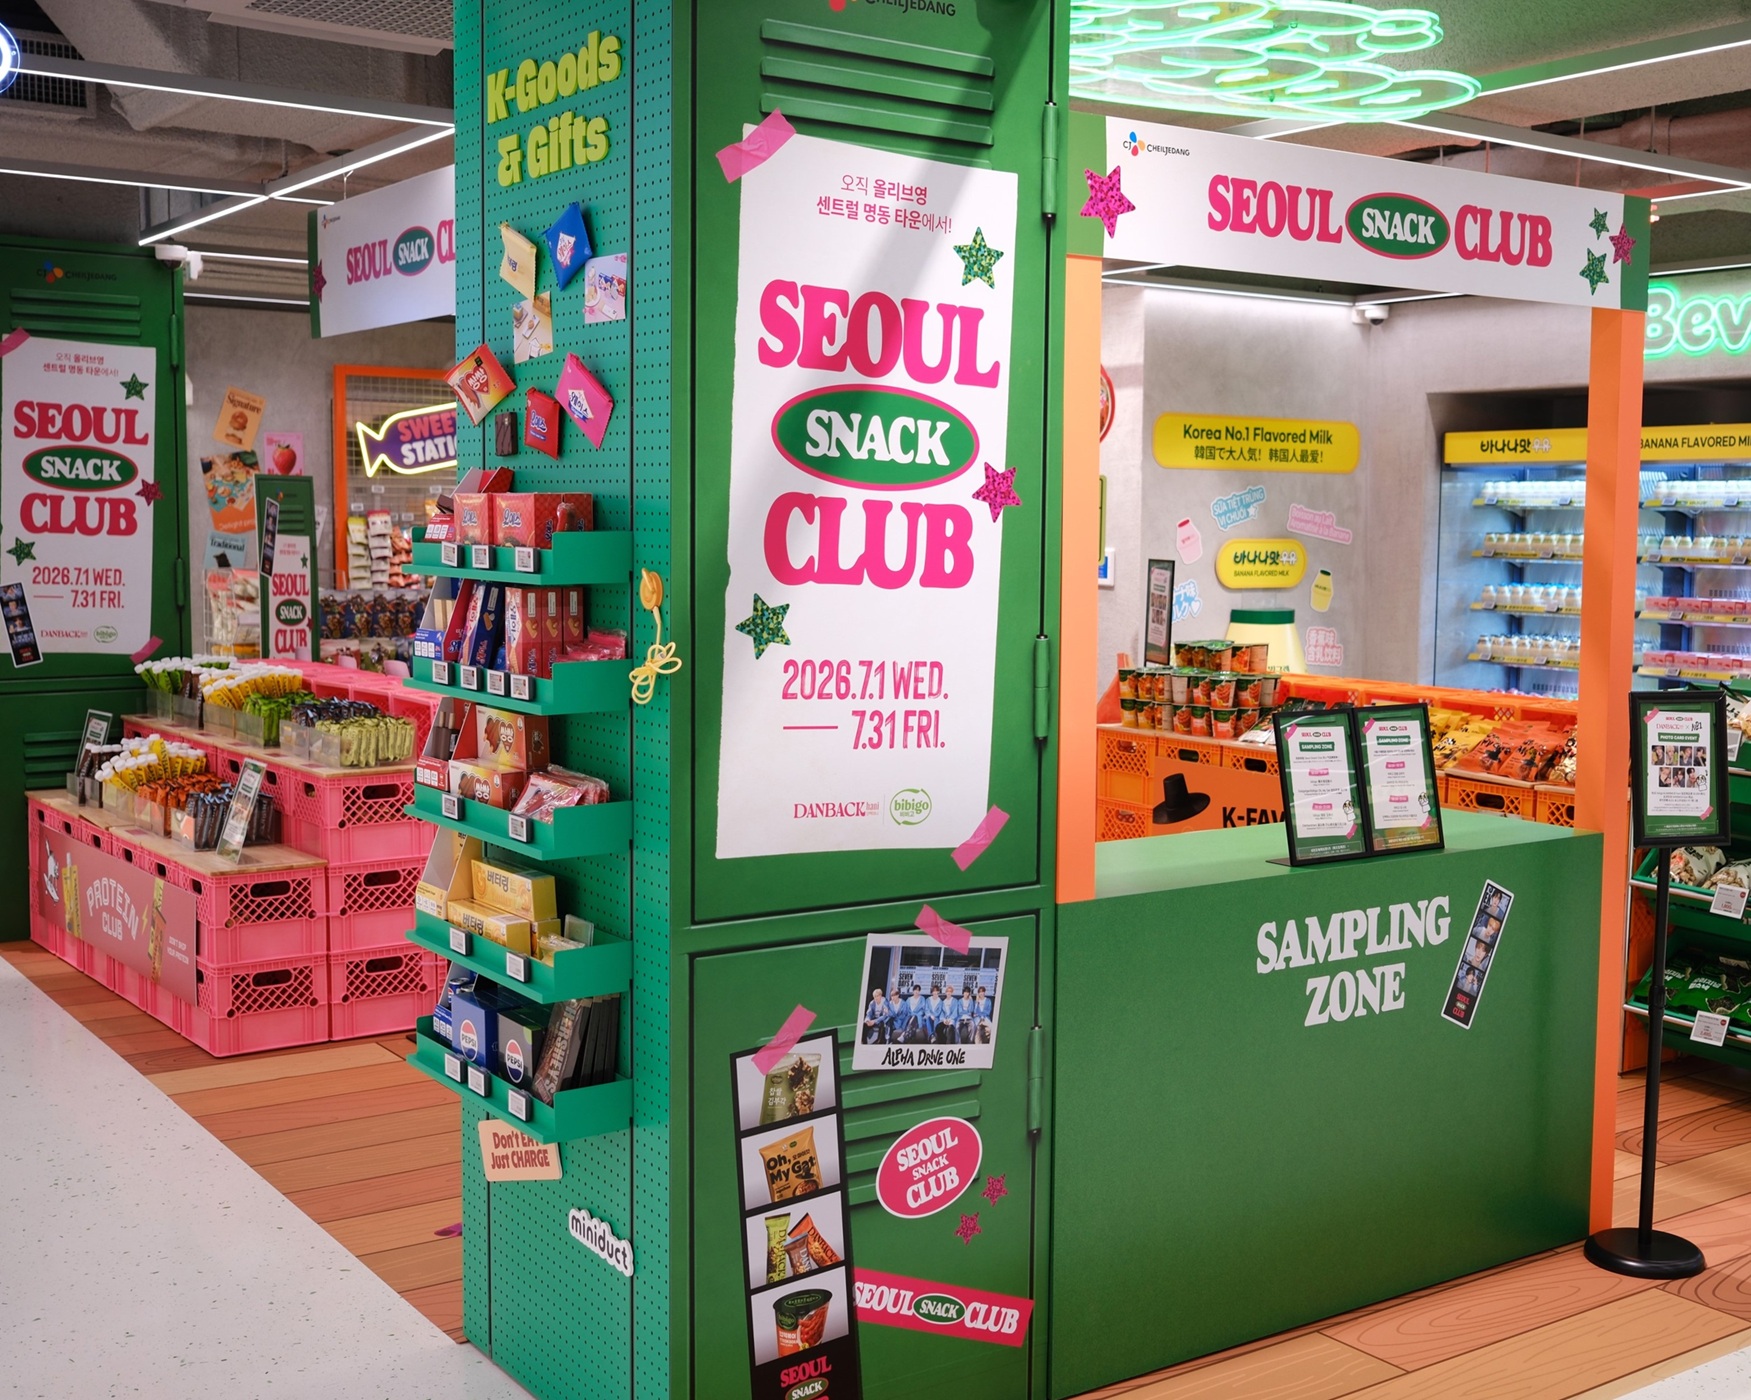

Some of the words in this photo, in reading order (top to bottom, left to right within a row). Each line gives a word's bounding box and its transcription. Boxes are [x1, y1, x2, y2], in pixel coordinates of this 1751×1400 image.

[866, 0, 956, 17] HEILJEDANG
[487, 30, 622, 123] K-Goods
[497, 134, 523, 187] &
[527, 111, 609, 179] Gifts
[1123, 140, 1132, 150] CJ
[1146, 144, 1190, 156] CHEILJEDANG
[841, 174, 868, 196] 오직
[872, 178, 928, 206] 올리브영
[816, 195, 860, 221] 센트럴
[863, 202, 891, 225] 명동
[894, 208, 952, 234] 타운에서!
[1207, 174, 1343, 244] SEOUL
[1361, 207, 1435, 245] SNACK
[1454, 203, 1553, 268] CLUB
[346, 239, 392, 286] SEOUL
[398, 236, 429, 266] SNACK
[757, 279, 1001, 389] SEOUL
[68, 364, 84, 376] 명동
[73, 353, 105, 365] 올리브영
[226, 392, 262, 415] Signature
[14, 400, 149, 446] SEOUL
[1183, 424, 1222, 440] Korea
[1225, 426, 1250, 441] No.1
[1253, 427, 1307, 445] Flavored
[1309, 430, 1333, 445] Milk
[805, 409, 951, 466] SNACK
[1480, 438, 1551, 455] 바나나맛우유
[1681, 436, 1736, 448] FLAVORED
[40, 456, 122, 482] SNACK
[20, 492, 138, 537] CLUB
[211, 538, 245, 552] Traditional
[763, 491, 975, 590] CLUB
[1233, 551, 1297, 566] 바나나맛우유
[32, 566, 90, 586] 2026.7.1
[93, 568, 126, 587] WED.
[272, 573, 310, 597] SEOUL
[70, 589, 97, 608] 7.31
[100, 590, 125, 609] FRI.
[279, 604, 303, 619] SNACK
[40, 629, 80, 638] DANBACK
[782, 659, 885, 700] 2026.7.1
[892, 660, 949, 700] WED.
[851, 709, 896, 749] 7.31
[903, 709, 946, 749] FRI.
[793, 801, 866, 819] DANBACK
[894, 797, 930, 815] bibigo
[487, 870, 509, 893] 버터링
[86, 877, 139, 941] PROTEIN
[102, 911, 123, 941] CLUB
[462, 913, 484, 936] 버터링
[1256, 895, 1451, 974] SAMPLING
[1304, 962, 1406, 1027] ZONE
[461, 1033, 478, 1049] PEPSI
[506, 1053, 523, 1070] PEPSI
[881, 1047, 915, 1067] ALPHA
[917, 1048, 944, 1066] DRIVE
[945, 1047, 966, 1065] ONE
[492, 1131, 519, 1149] Don't
[896, 1127, 959, 1172] SEOUL
[491, 1152, 510, 1170] Just
[511, 1149, 550, 1168] CHARGE
[766, 1154, 791, 1171] Oh,
[912, 1154, 949, 1181] SNACK
[769, 1167, 790, 1185] My
[906, 1166, 960, 1209] CLUB
[571, 1214, 629, 1270] miniduct
[853, 1281, 914, 1316] SEOUL
[919, 1299, 960, 1319] SNACK
[964, 1302, 1020, 1334] CLUB
[780, 1356, 832, 1388] SEOUL
[791, 1380, 823, 1400] SNACK
